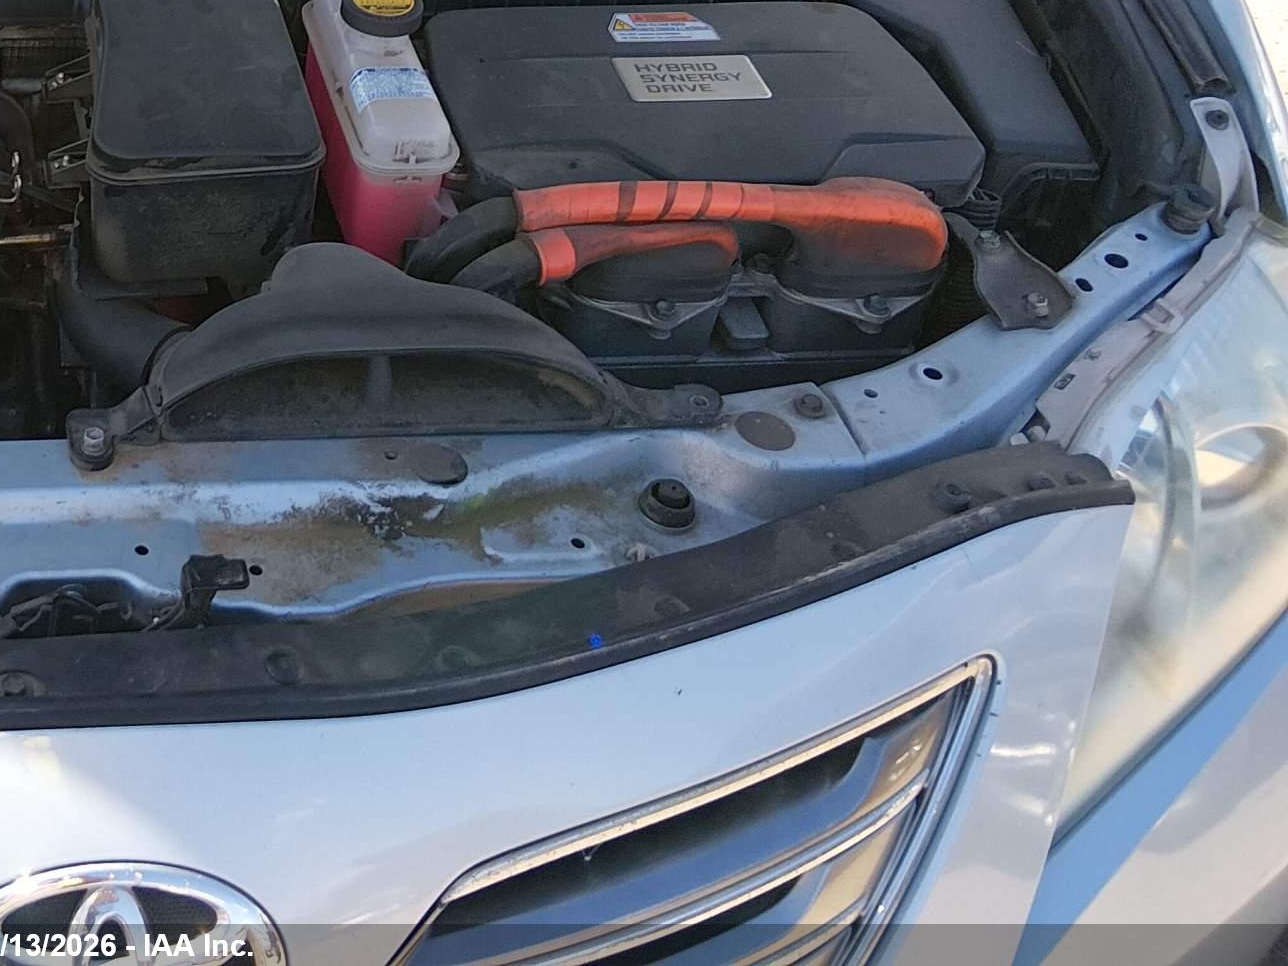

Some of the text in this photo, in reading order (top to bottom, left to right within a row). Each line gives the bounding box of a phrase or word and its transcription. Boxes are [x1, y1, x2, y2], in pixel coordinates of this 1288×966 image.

[633, 62, 718, 73] HYBRID
[639, 72, 742, 83] SYNERGY
[645, 83, 714, 94] DRIVE
